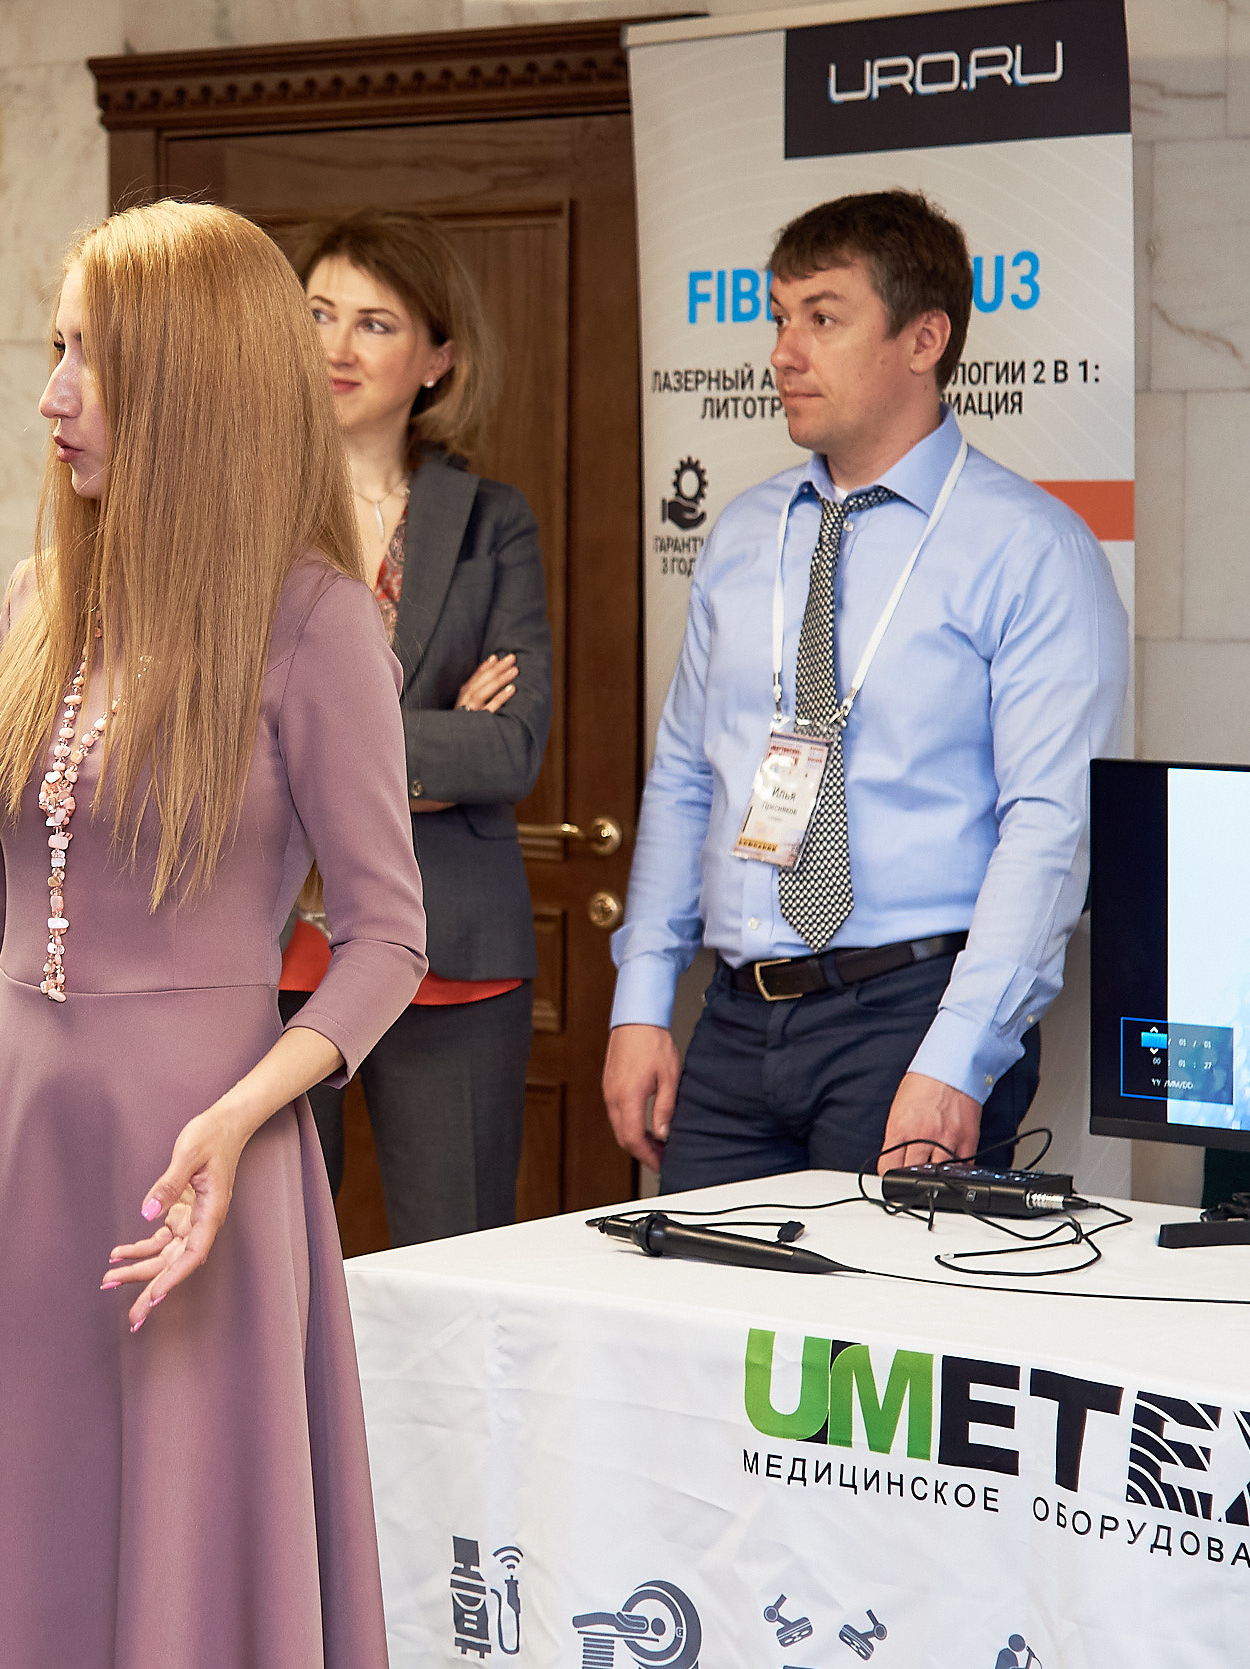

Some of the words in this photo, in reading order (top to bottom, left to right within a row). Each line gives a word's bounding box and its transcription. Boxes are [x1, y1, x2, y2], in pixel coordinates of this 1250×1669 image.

[828, 40, 1064, 102] URO.RU
[972, 250, 1042, 313] U3
[652, 362, 755, 393] ЛАЗЕРНЫЙ
[761, 367, 779, 391] А
[1033, 360, 1046, 384] 2
[701, 396, 788, 419] ЛИТОТР
[772, 787, 796, 800] Илья
[743, 1448, 1000, 1513] МЕДИЦИНСКОЕ
